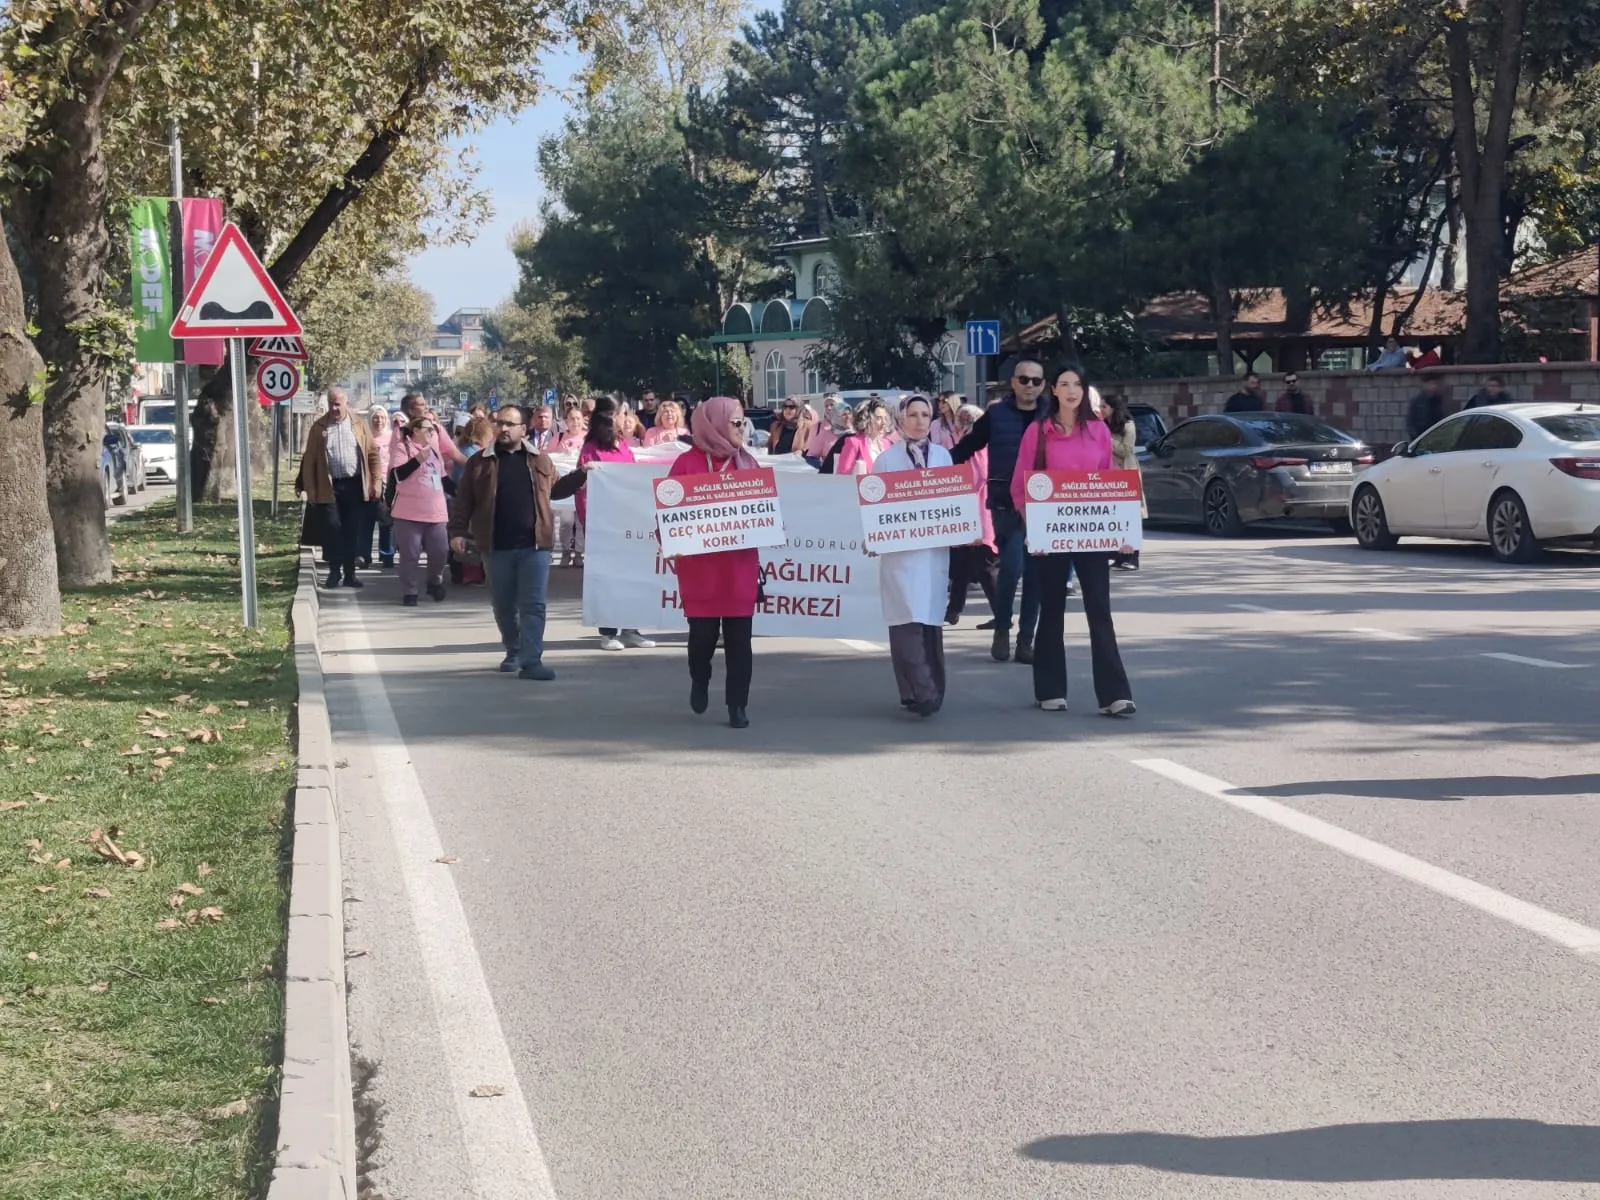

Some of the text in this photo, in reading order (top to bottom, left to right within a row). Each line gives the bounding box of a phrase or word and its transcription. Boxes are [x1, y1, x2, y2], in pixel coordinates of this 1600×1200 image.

[265, 370, 291, 390] 30
[720, 473, 735, 481] T.C.
[920, 470, 934, 478] T.C.
[1088, 472, 1101, 480] T.C.
[693, 478, 764, 493] SAĞLIK BAKANLIĞI
[894, 475, 963, 490] SAĞLIK BAKANLIĞI
[1061, 480, 1128, 490] SAĞLIK BAKANLIĞI
[662, 499, 776, 524] KANSERDEN DEĞİL
[878, 504, 962, 525] ERKEN TEŞHİS
[1057, 505, 1110, 517] KORKMA
[669, 517, 775, 538] GEÇ KALMAKTAN
[867, 528, 906, 543] HAYAT
[910, 521, 970, 539] KURTARIR
[1046, 521, 1105, 533] FARKINDA
[1108, 521, 1122, 532] OL
[626, 530, 655, 541] BUR
[785, 538, 857, 550] ÜDÜRLÜ
[703, 535, 738, 548] KORK
[1051, 539, 1074, 552] GEÇ
[1077, 537, 1119, 549] KALMA
[764, 558, 851, 584] AĞLIKLI
